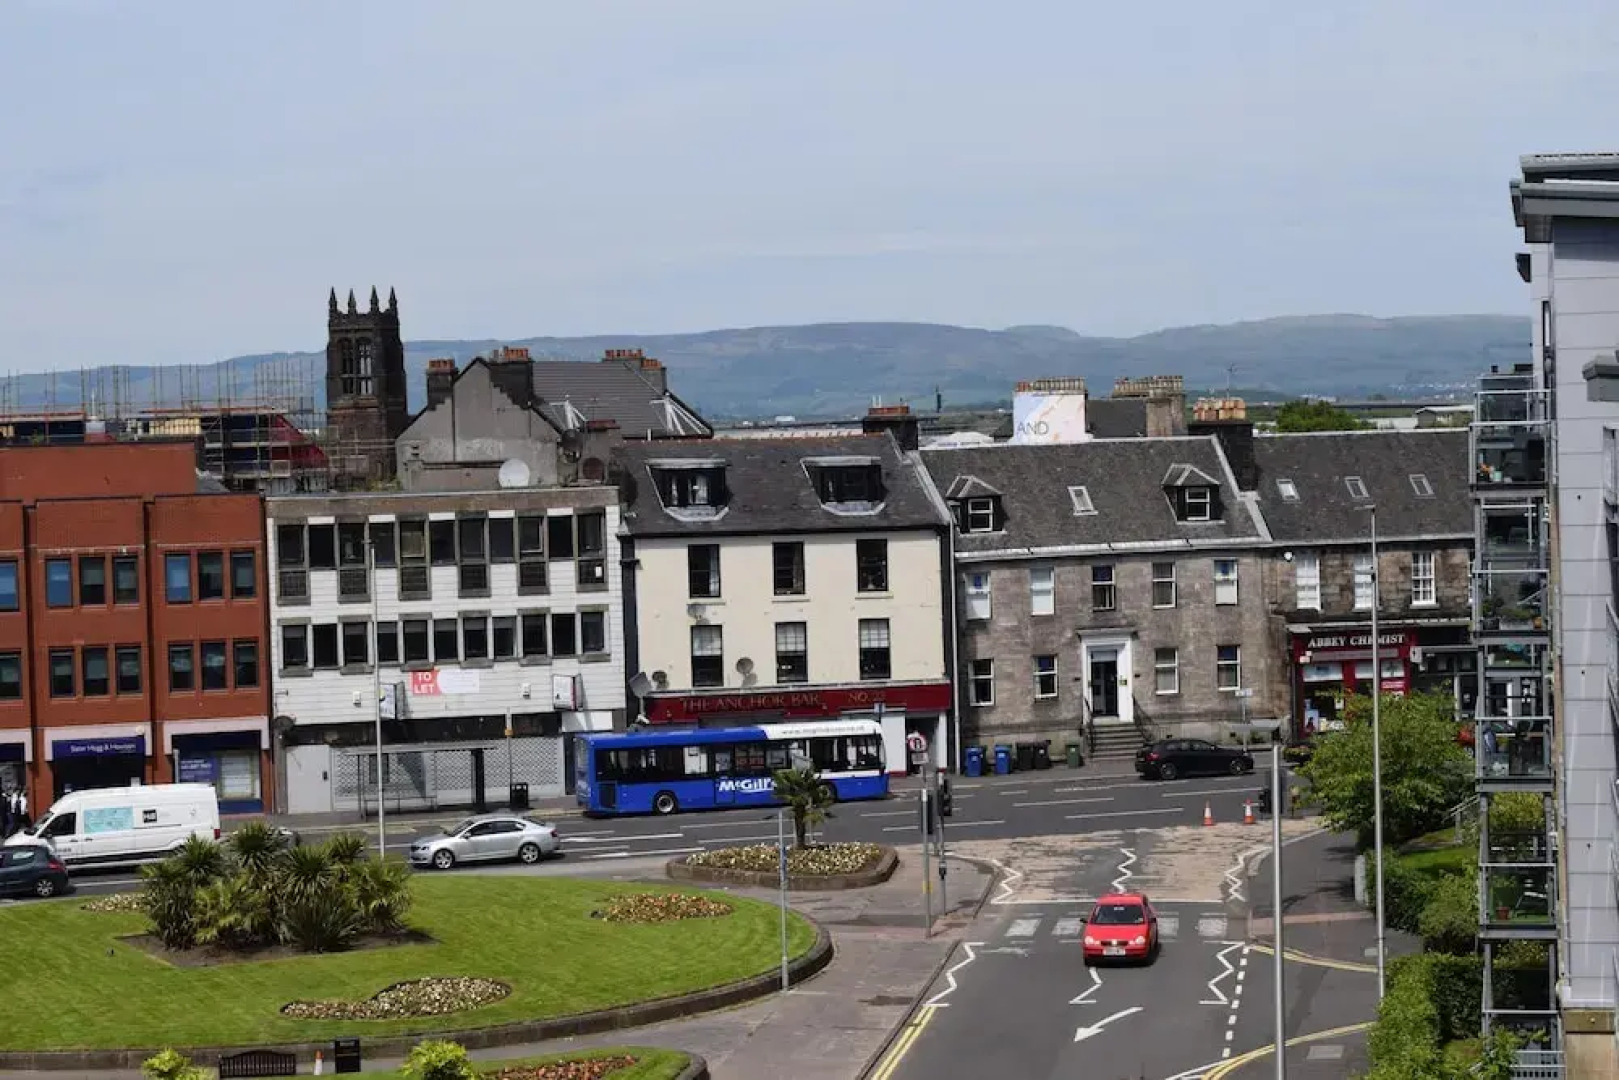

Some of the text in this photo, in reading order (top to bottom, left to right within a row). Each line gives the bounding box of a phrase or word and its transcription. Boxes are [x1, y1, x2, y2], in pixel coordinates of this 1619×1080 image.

[1016, 421, 1049, 435] AND
[1308, 634, 1405, 648] ABBEY CHEMIST
[416, 672, 432, 681] TO
[414, 684, 435, 694] LET
[680, 692, 822, 713] THE ANCHOR BAR
